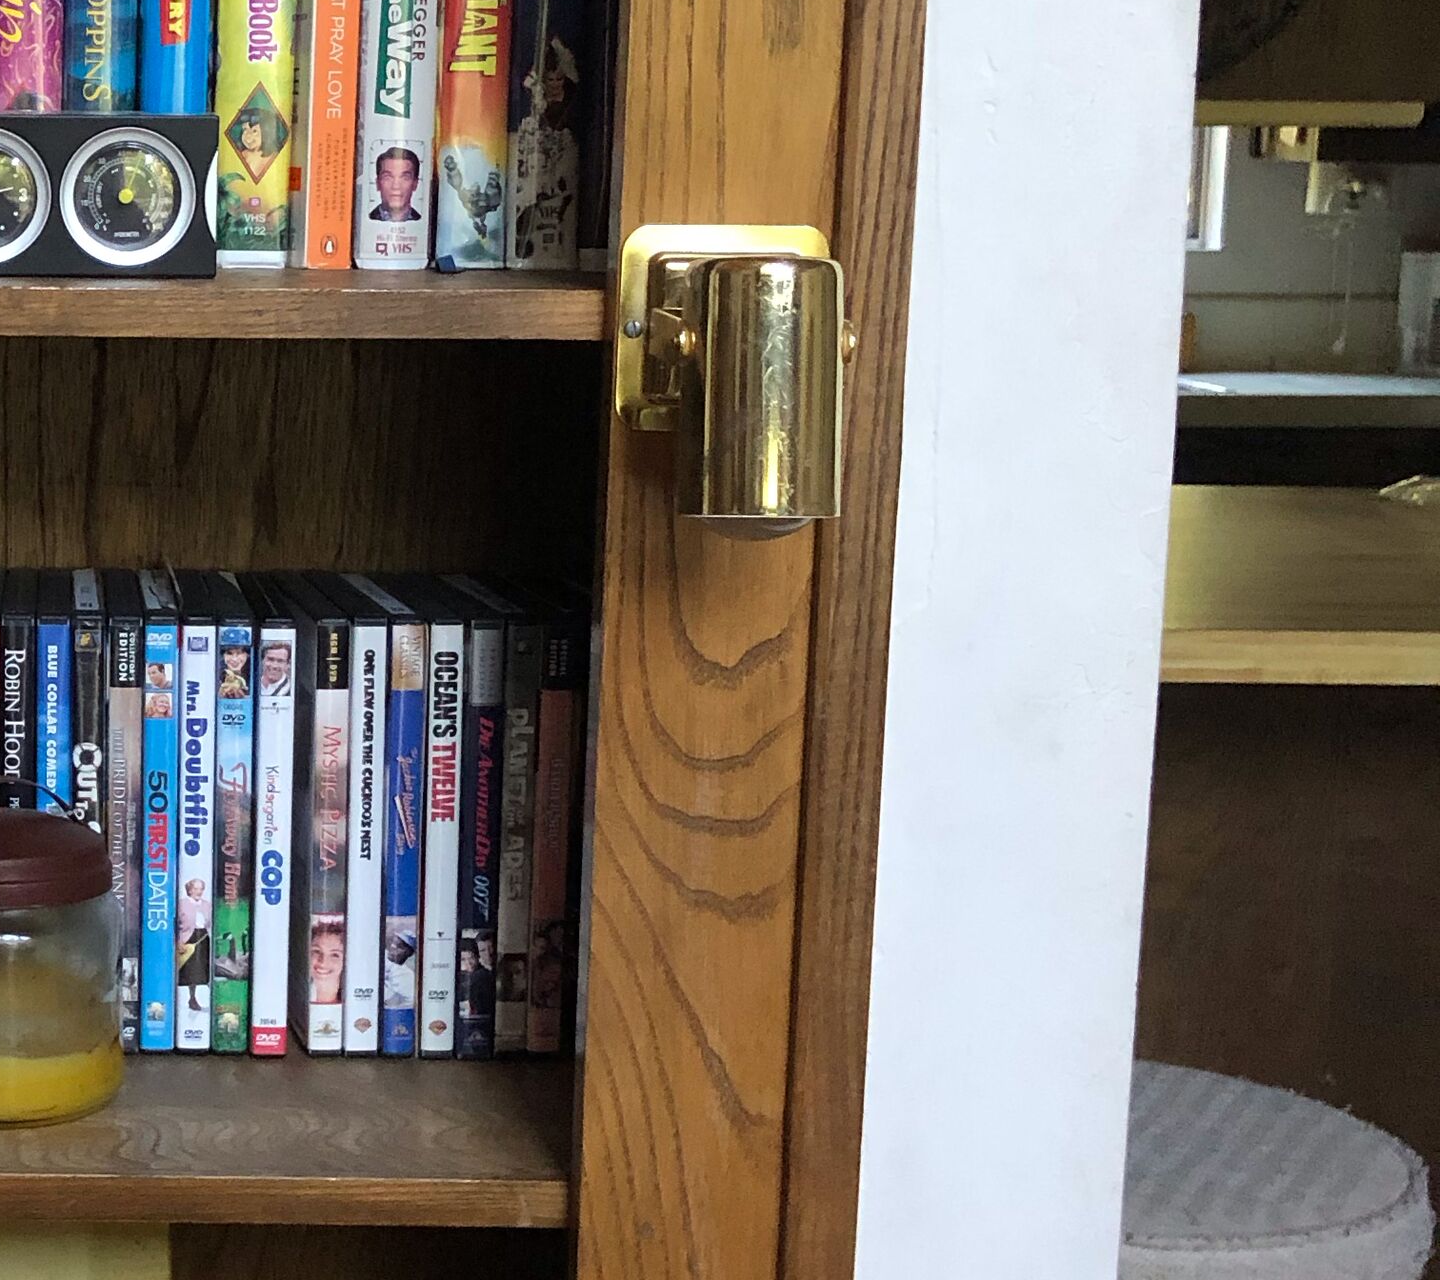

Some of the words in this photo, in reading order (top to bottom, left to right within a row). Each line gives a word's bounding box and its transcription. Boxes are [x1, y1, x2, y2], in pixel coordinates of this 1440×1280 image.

[327, 15, 346, 69] PRAY
[378, 19, 414, 115] Way
[324, 69, 344, 120] LOVE
[18, 187, 28, 203] 3
[3, 647, 27, 712] ROBIN
[46, 644, 59, 678] BLUE
[118, 631, 128, 681] EDITION
[128, 631, 137, 682] COLLECTOR'S
[363, 649, 376, 677] ONE
[46, 682, 59, 734] COLLAR
[185, 680, 201, 717] Mrs.
[363, 677, 375, 710] FLEW
[432, 650, 460, 738] OCEAN'S
[362, 710, 375, 744] OVER
[71, 742, 103, 801] OUT
[112, 757, 127, 807] PRIDE
[318, 725, 342, 800] MYSTIC
[361, 744, 374, 766] THE
[505, 706, 534, 805] PLANET
[147, 769, 169, 813] 50
[184, 717, 209, 857] Doubtfire
[261, 765, 281, 846] Kindergarten
[360, 767, 374, 828] CUCKOO'S
[430, 742, 458, 823] TWELVE
[147, 812, 169, 872] FIRST
[318, 808, 344, 871] PIZZA
[359, 829, 372, 861] NEST
[146, 870, 169, 932] DATES
[260, 849, 284, 906] COP
